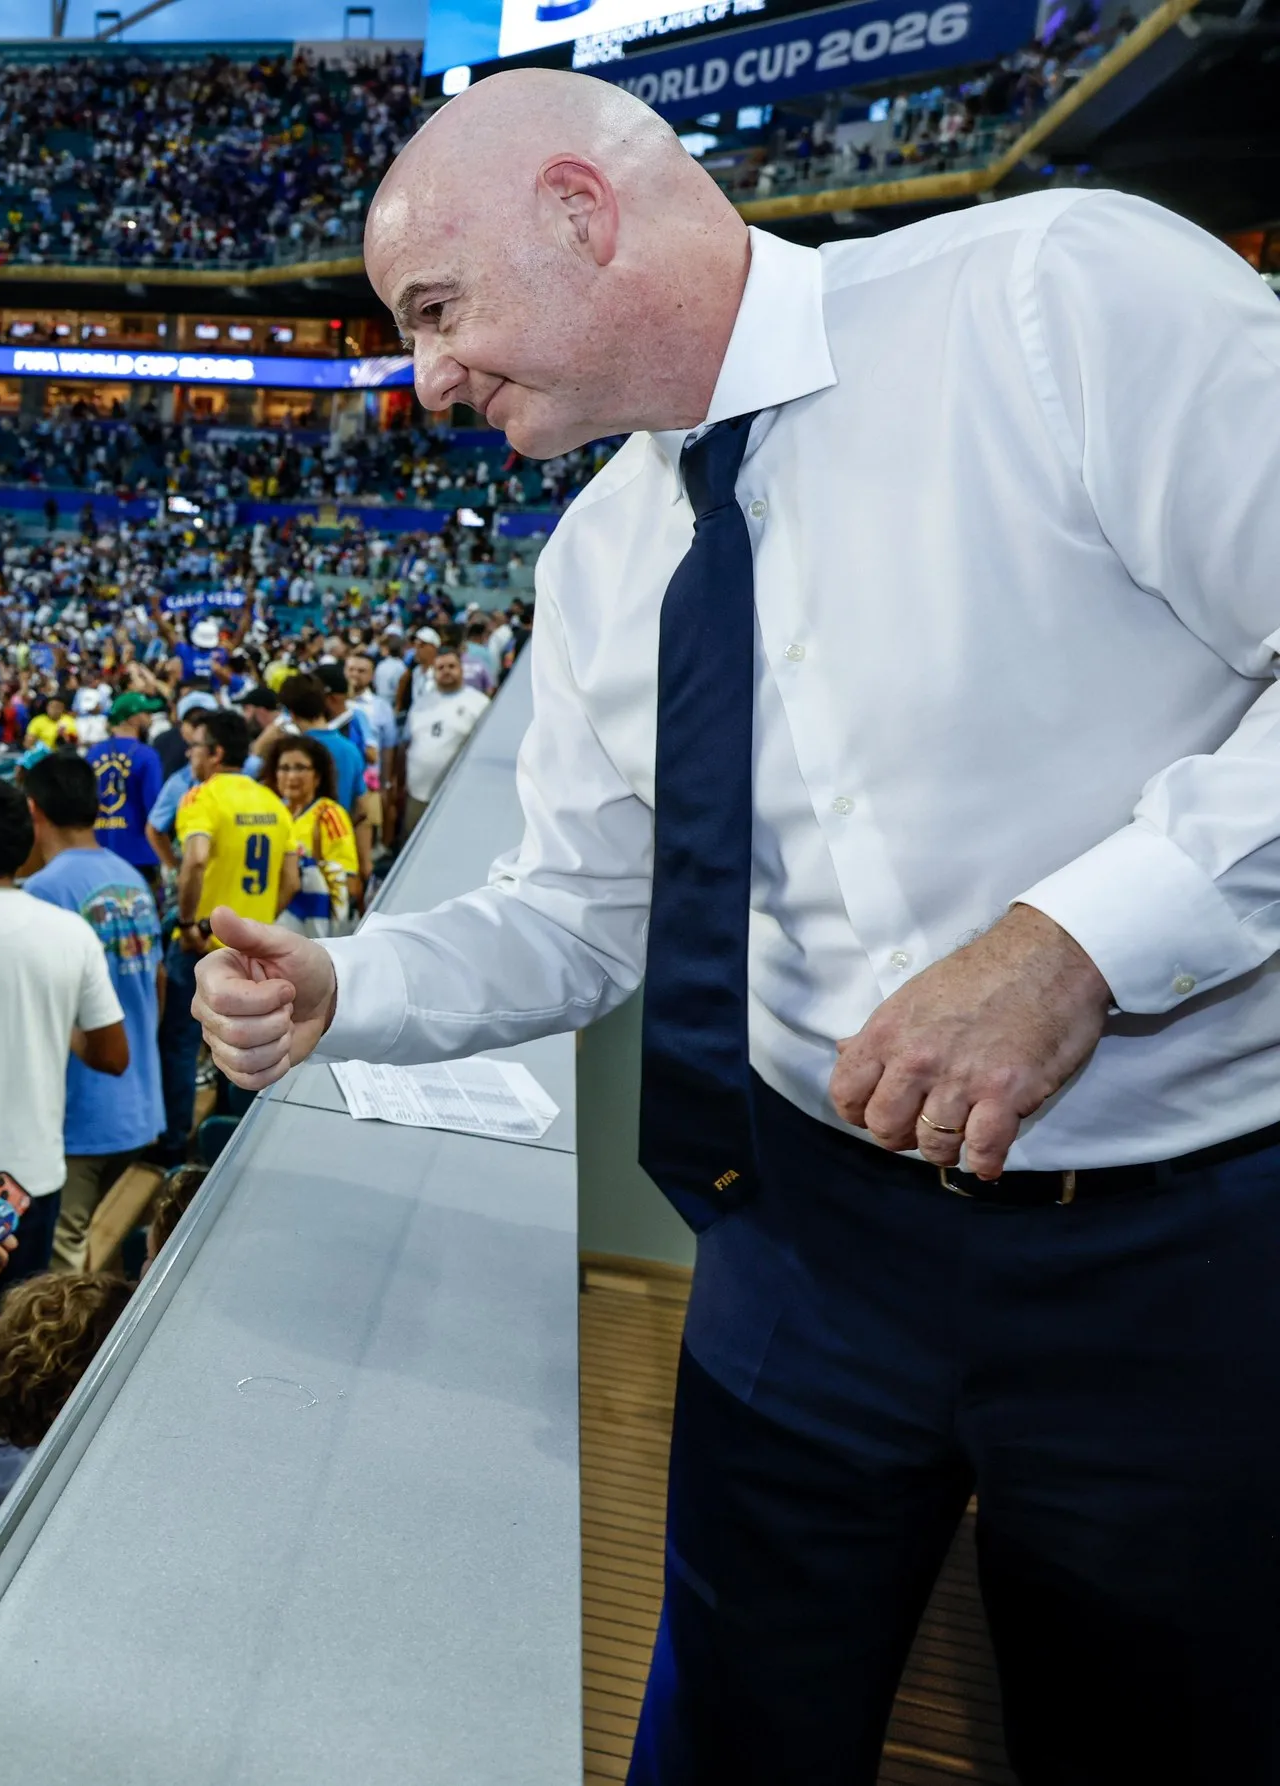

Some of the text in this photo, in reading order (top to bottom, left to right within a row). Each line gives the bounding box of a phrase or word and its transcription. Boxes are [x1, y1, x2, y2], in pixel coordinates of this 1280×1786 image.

[733, 39, 812, 87] CUP
[815, 2, 971, 72] 2026
[241, 832, 270, 895] 9
[714, 1169, 740, 1191] FIFA
